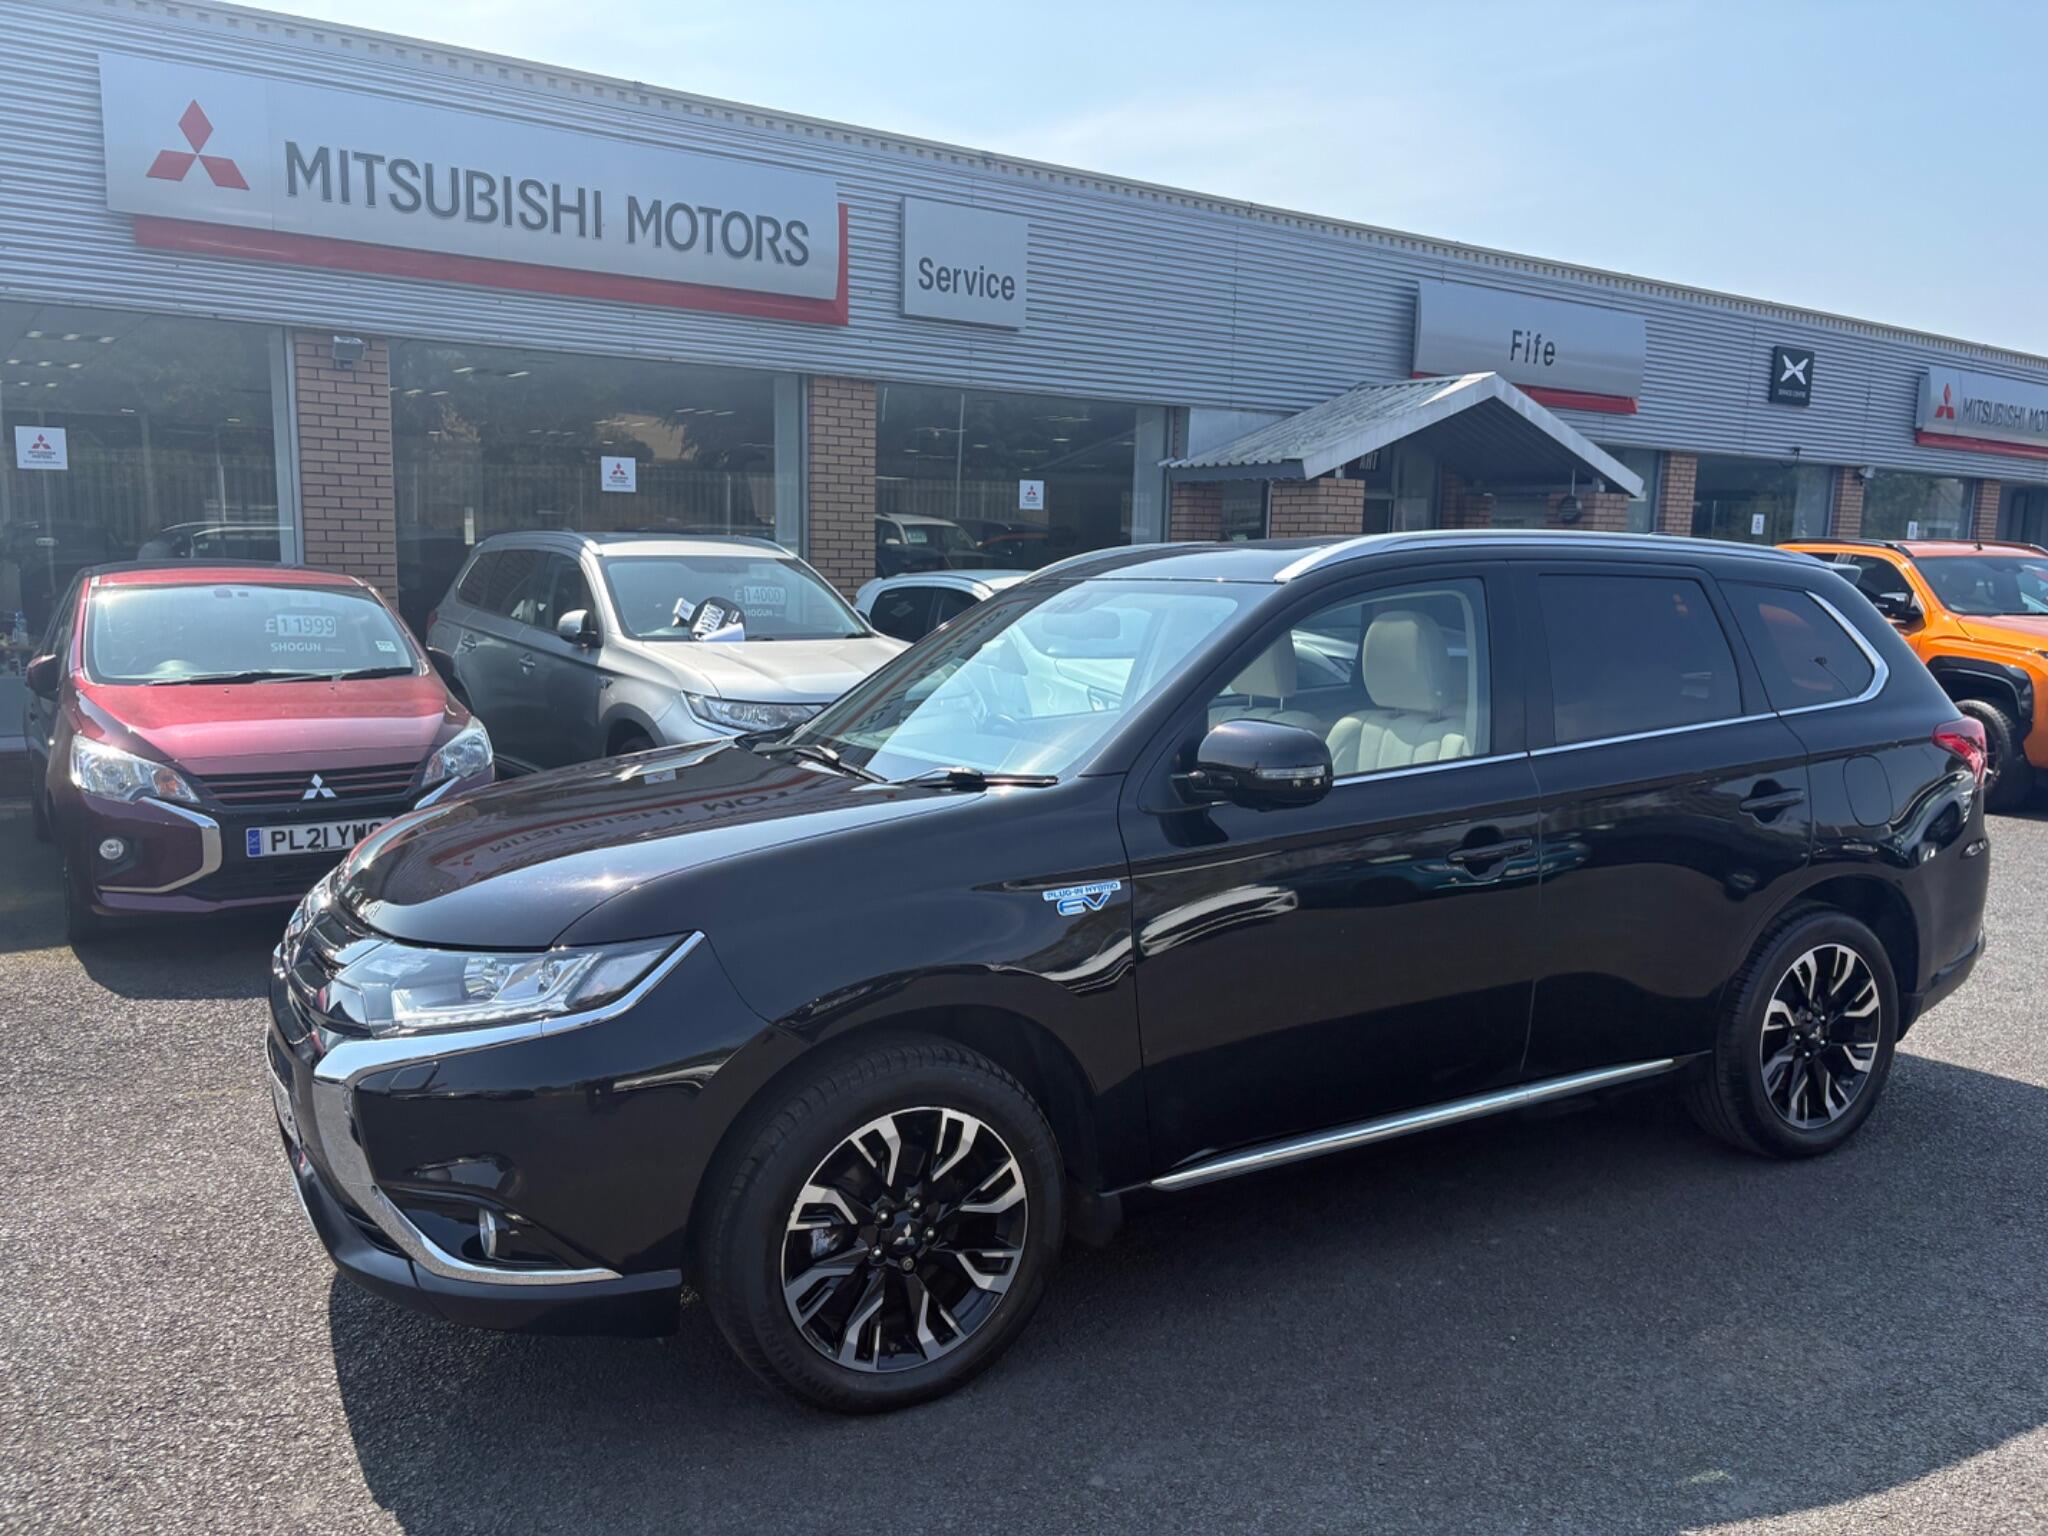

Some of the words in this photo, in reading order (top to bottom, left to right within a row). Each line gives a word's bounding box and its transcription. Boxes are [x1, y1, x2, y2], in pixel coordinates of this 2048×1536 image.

[285, 140, 603, 241] MITSUBISHI
[627, 195, 810, 267] MOTORS
[918, 256, 1016, 301] Service
[1509, 329, 1556, 367] Fife
[1963, 398, 2026, 428] MITSUBISHI
[269, 641, 321, 653] SHOGUN
[271, 826, 329, 852] PL21
